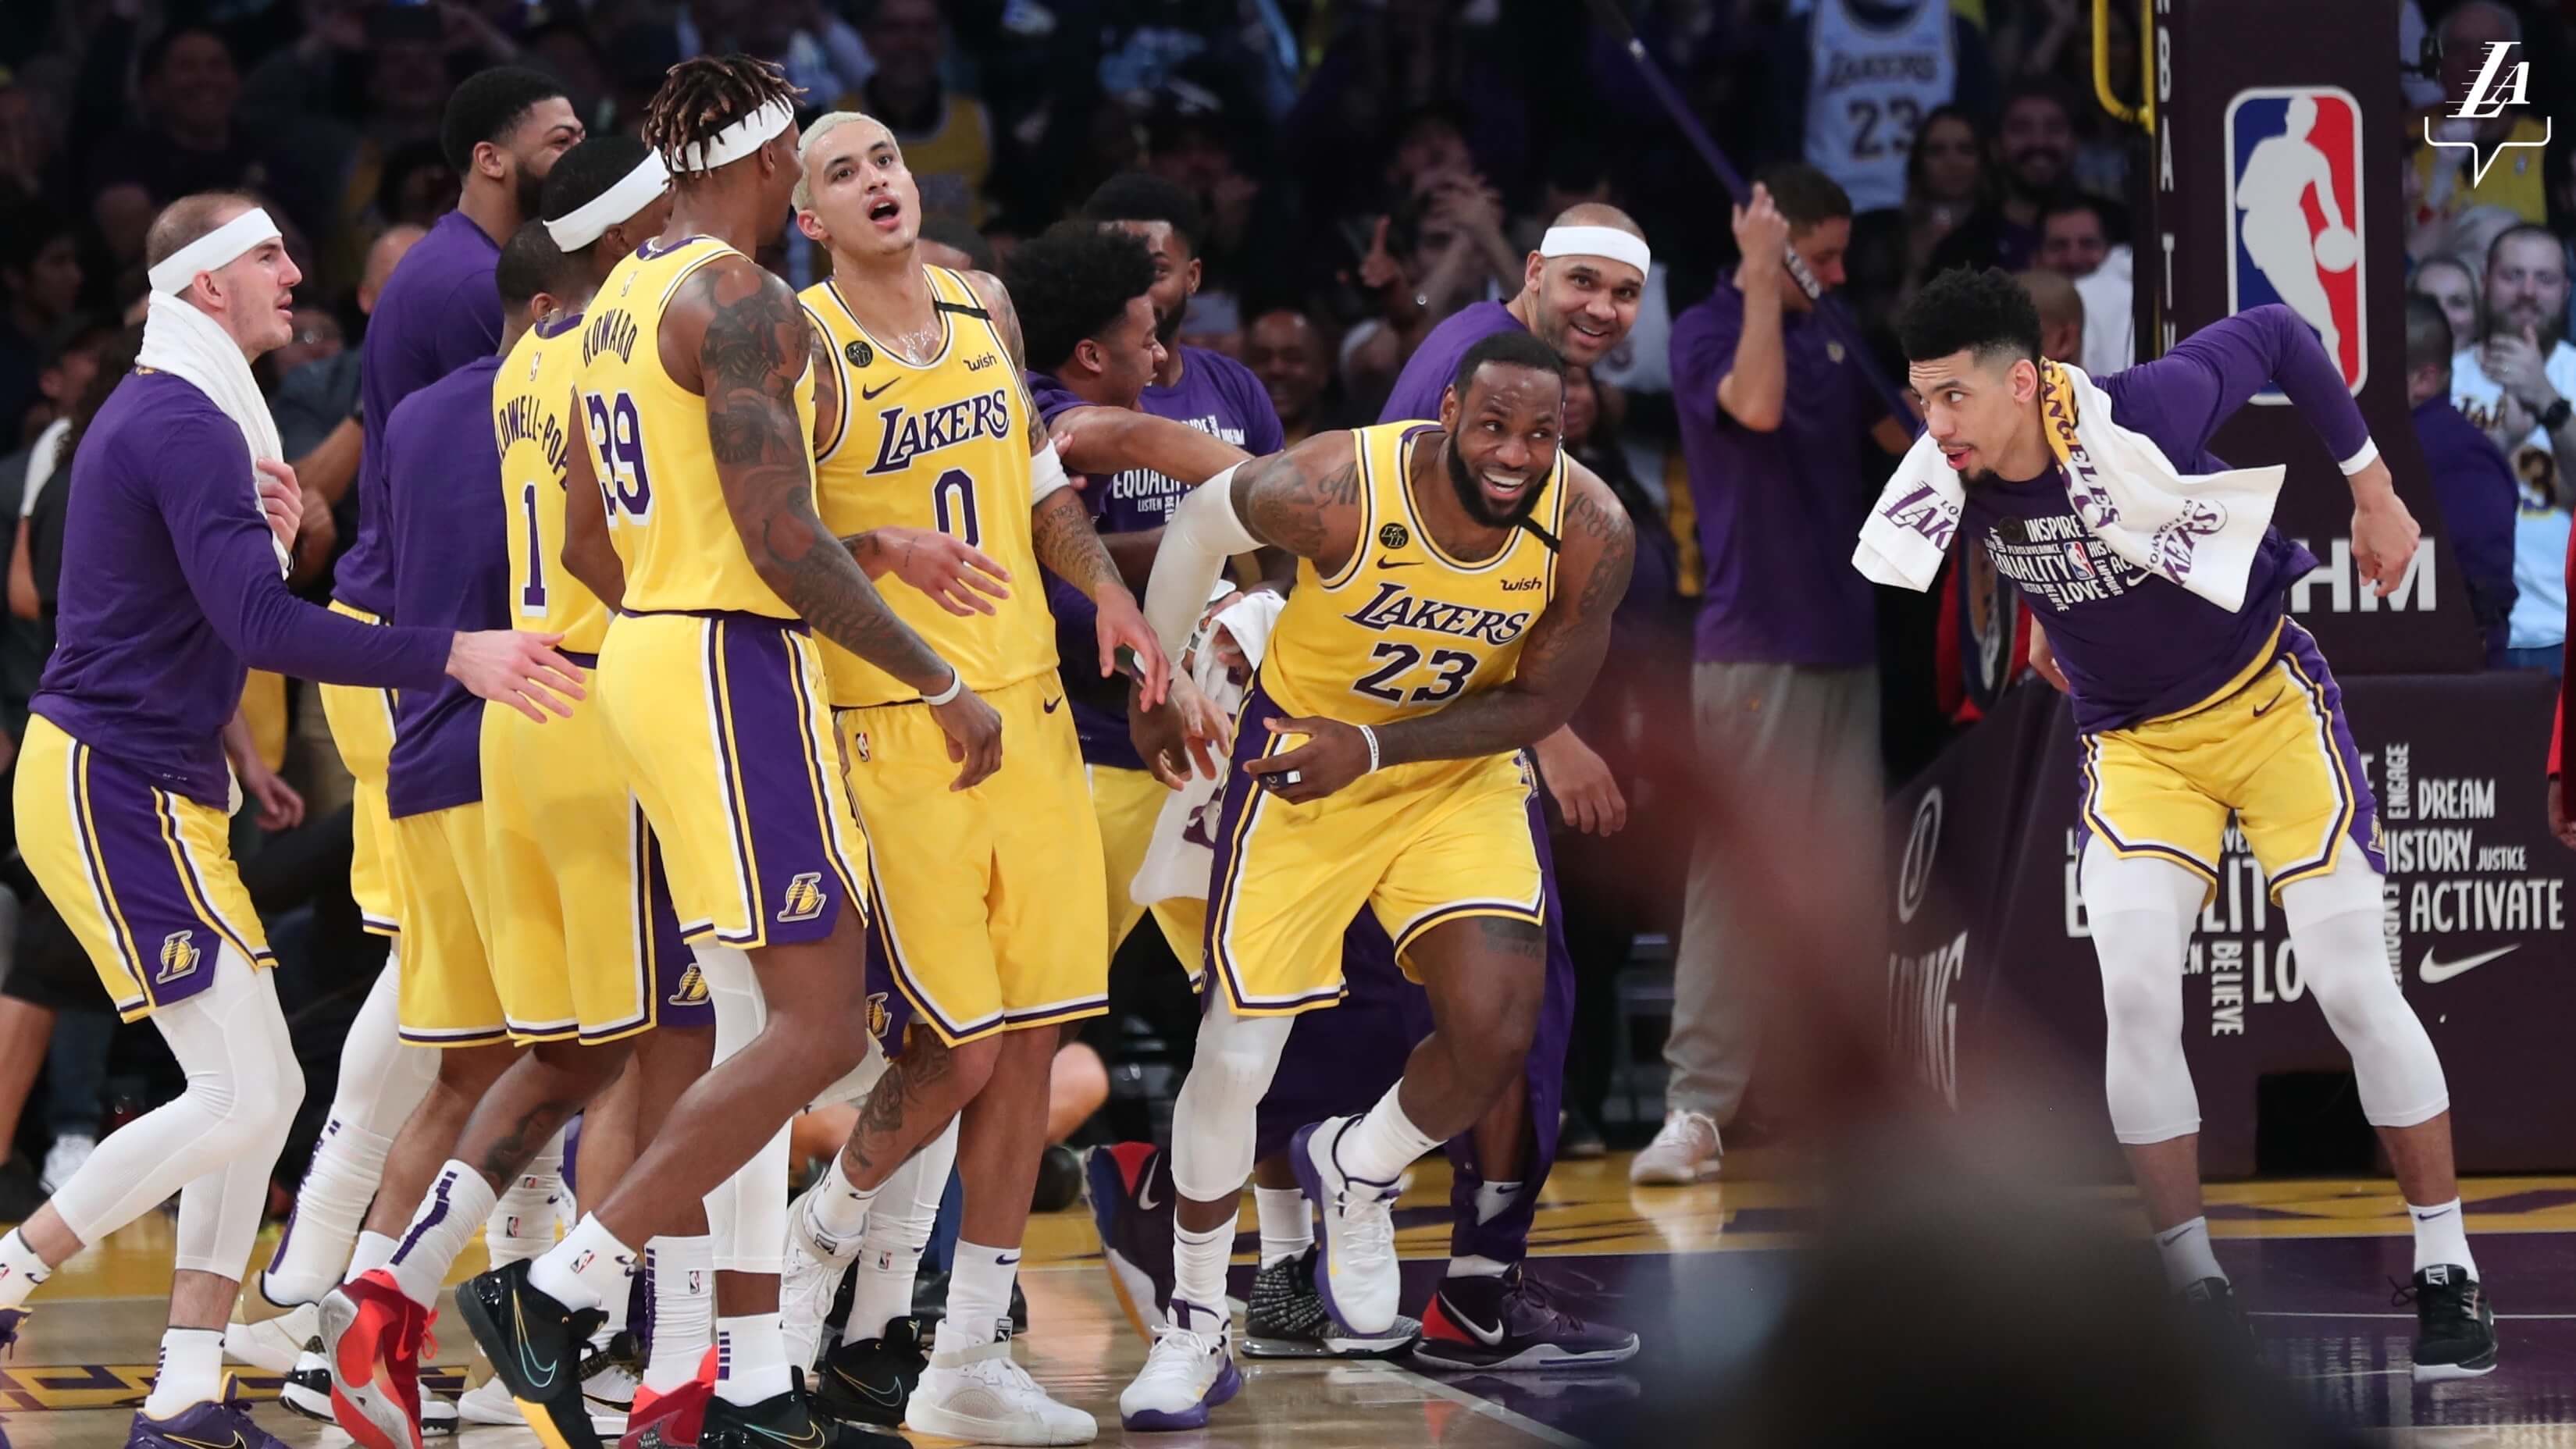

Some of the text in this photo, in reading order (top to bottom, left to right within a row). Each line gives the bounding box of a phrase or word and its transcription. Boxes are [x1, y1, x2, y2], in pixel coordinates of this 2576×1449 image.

[2157, 0, 2175, 192] BA
[583, 308, 638, 368] HOWARD
[963, 351, 998, 372] wish
[497, 394, 568, 491] DWELL-POP
[585, 390, 651, 526] 39
[864, 389, 1011, 476] LAKERS
[933, 468, 981, 550] 0
[1113, 468, 1192, 499] EQUALI
[1137, 497, 1163, 512] LISTEN
[1940, 499, 1961, 520] LO
[522, 481, 547, 618] 1
[2025, 514, 2085, 543] INSPIRE
[1501, 577, 1543, 592] wish
[1989, 550, 2072, 582] EQUALITY
[2056, 579, 2110, 604] LOVE
[2094, 559, 2125, 596] EMPOWER
[1345, 581, 1530, 646] LAKERS
[1352, 641, 1478, 704] 23
[2386, 742, 2410, 820] ENGAGE
[2418, 778, 2496, 819] DREAM
[2475, 846, 2527, 871] JUSTICE
[2409, 878, 2565, 933] ACTIVATE
[2211, 939, 2244, 1036] BELIEVE
